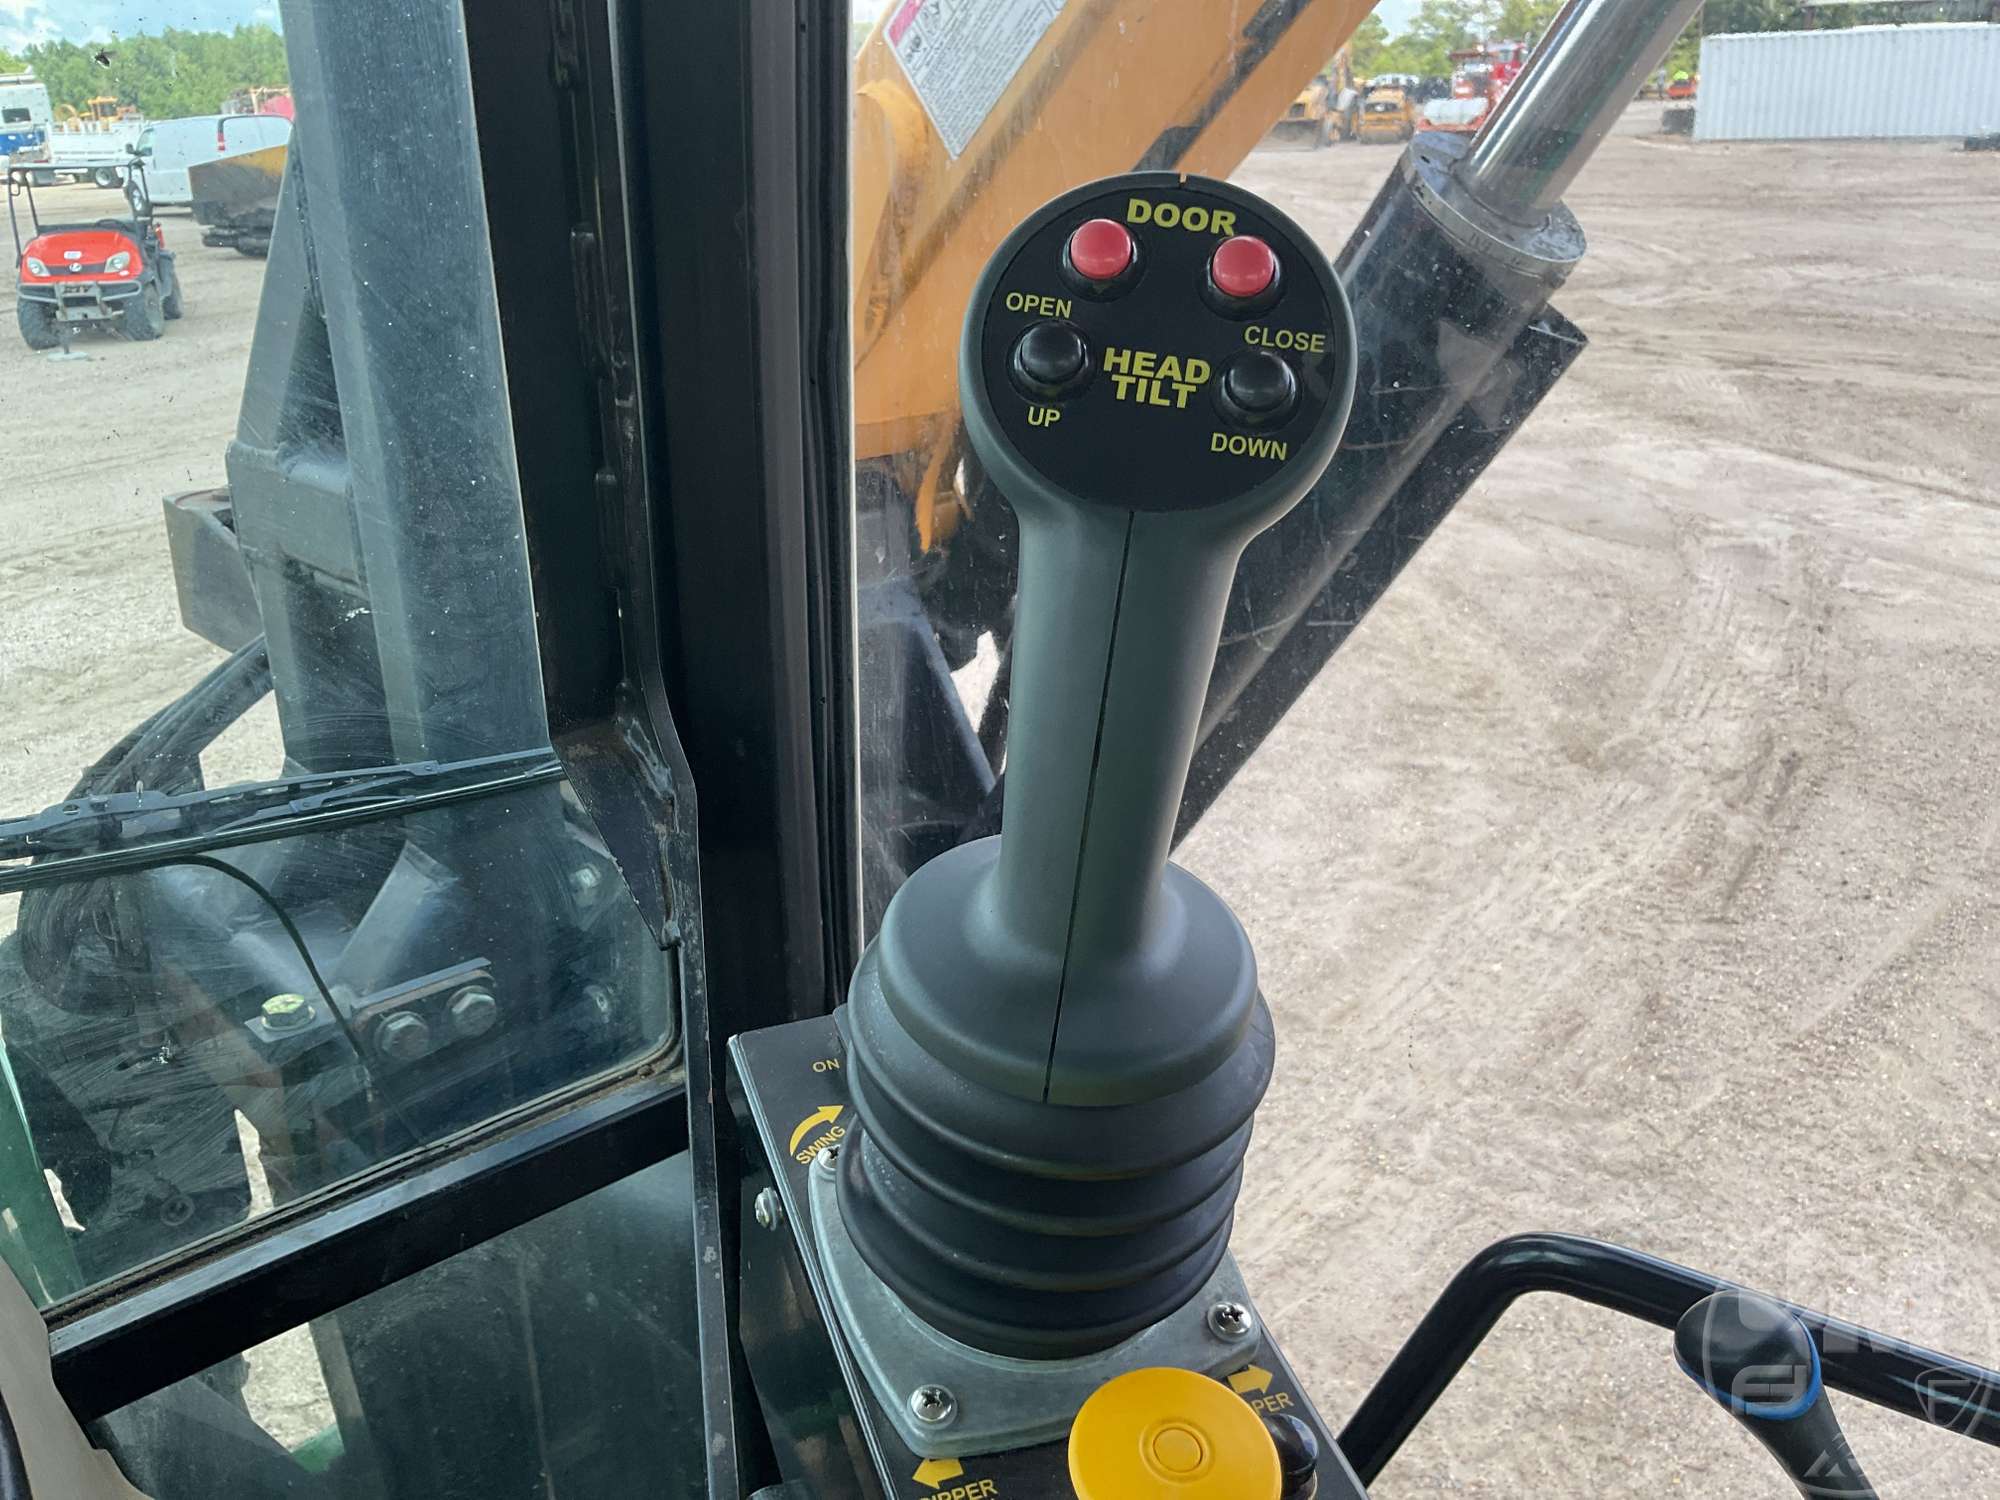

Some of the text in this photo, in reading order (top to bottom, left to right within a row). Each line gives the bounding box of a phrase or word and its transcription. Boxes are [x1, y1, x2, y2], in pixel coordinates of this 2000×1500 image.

[1127, 198, 1236, 236] DOOR
[1005, 292, 1072, 319] OPEN
[1244, 325, 1326, 353] CLOSE
[1103, 347, 1211, 384] HEAD
[1111, 374, 1197, 409] TILT
[1027, 406, 1061, 428] UP
[1210, 432, 1288, 460] DOWN
[812, 1058, 840, 1073] ON
[795, 1125, 846, 1165] SWING
[1251, 1392, 1294, 1416] PER
